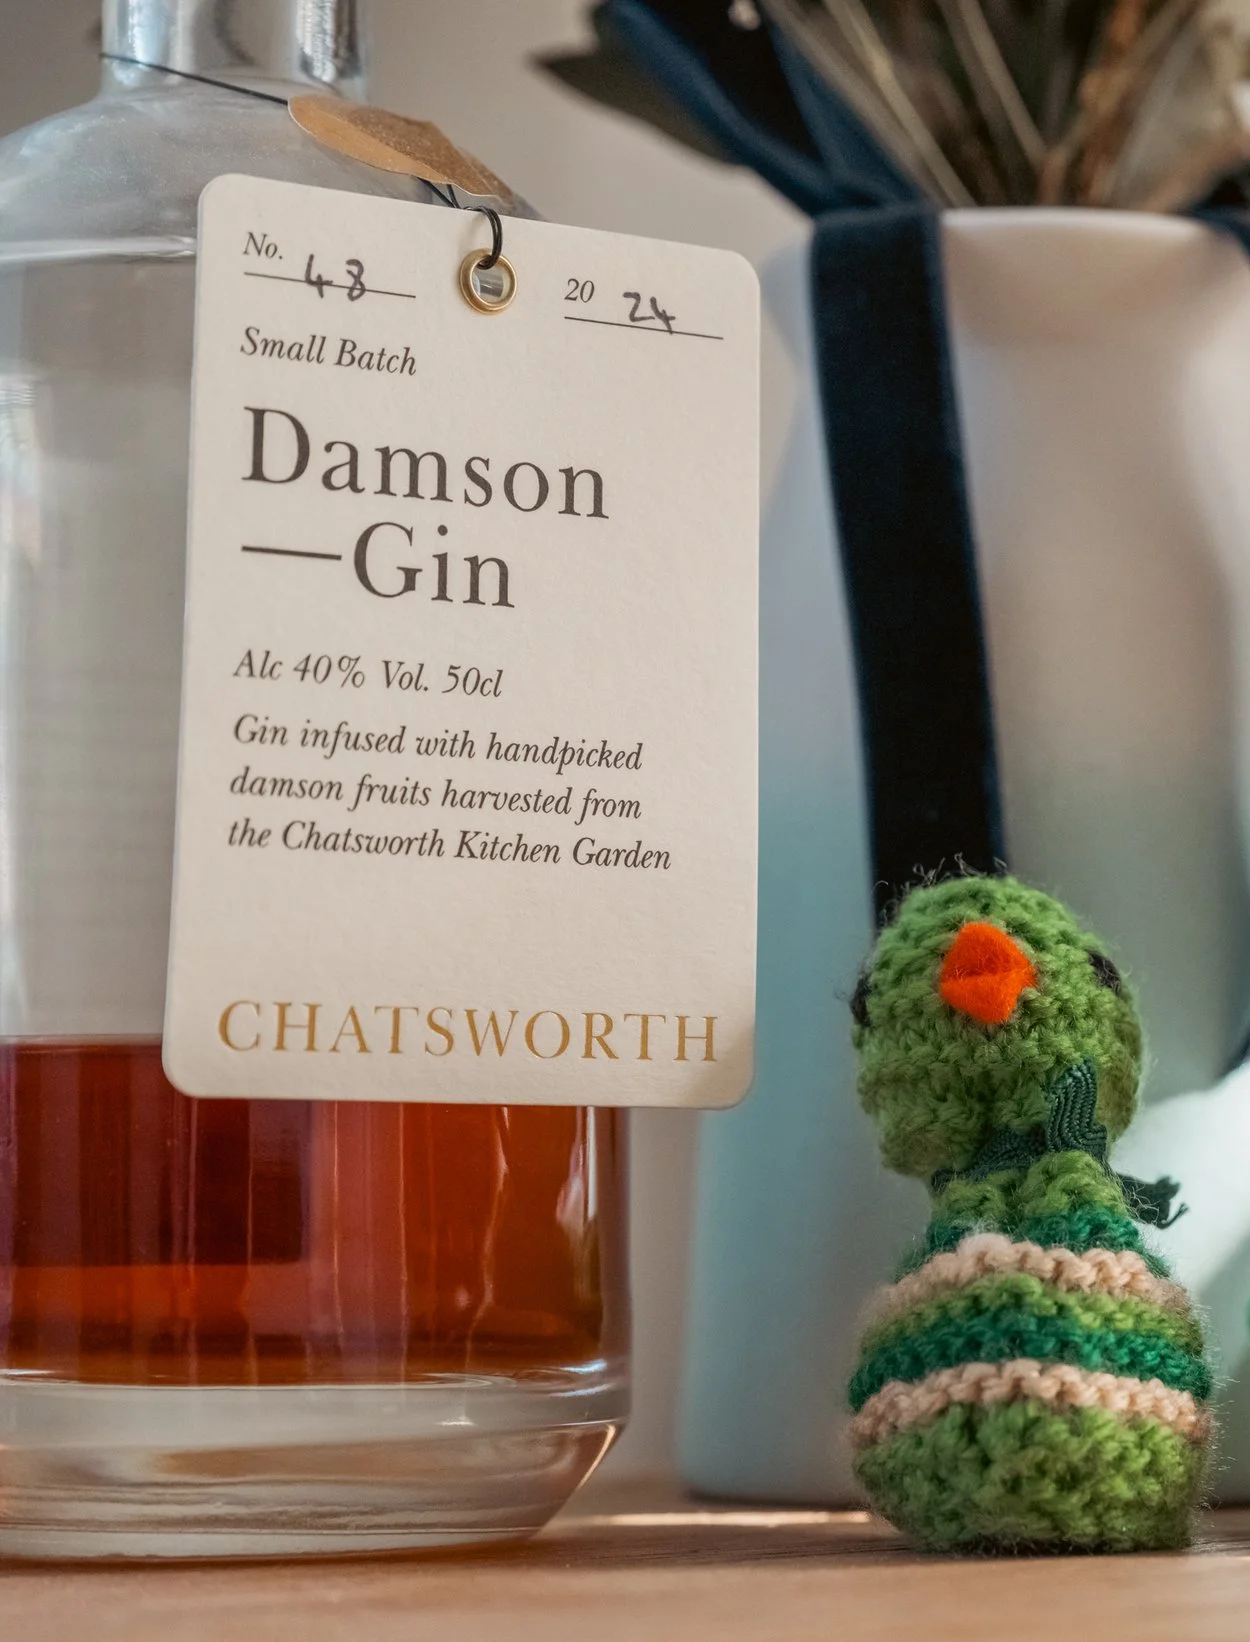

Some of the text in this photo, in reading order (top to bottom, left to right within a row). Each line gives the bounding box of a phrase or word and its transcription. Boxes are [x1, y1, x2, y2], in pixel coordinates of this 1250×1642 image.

[243, 230, 367, 301] No. 48
[564, 278, 677, 335] 20 24
[240, 326, 417, 377] Small Batch
[242, 405, 610, 520] Damson
[232, 649, 505, 699] Alc 40% Vol. 50cl
[233, 713, 643, 776] Gin infused with handpicked
[229, 766, 643, 825] damson fruits harvested from
[228, 818, 672, 871] the Chatsworth Kitchen Garden
[217, 1000, 719, 1063] CHATSWORTH
